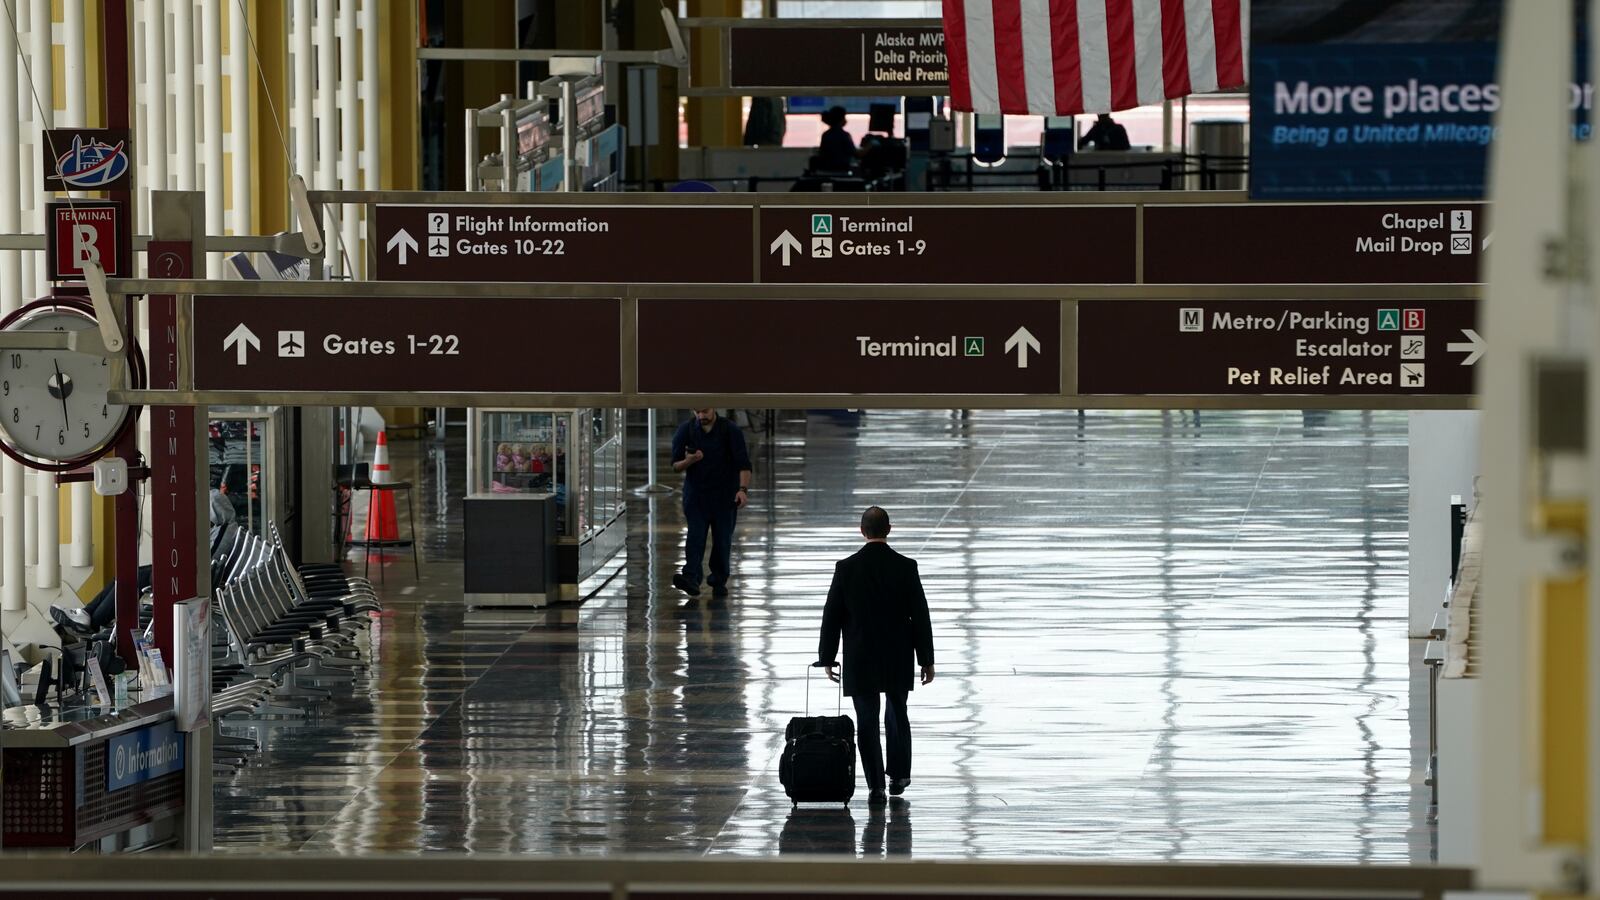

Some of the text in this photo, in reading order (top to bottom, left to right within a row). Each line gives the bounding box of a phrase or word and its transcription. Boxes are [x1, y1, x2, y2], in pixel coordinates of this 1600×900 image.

[875, 32, 945, 47] Alaska MVP
[874, 49, 905, 64] Delta
[874, 66, 950, 81] United Premi
[1274, 81, 1374, 114] More
[1384, 79, 1501, 119] places
[1271, 125, 1330, 147] Being
[1333, 127, 1349, 144] a
[1352, 123, 1421, 144] United
[60, 210, 112, 222] TERMINAL
[815, 215, 913, 233] A Terminal
[1381, 212, 1444, 233] Chapel
[455, 215, 609, 236] Flight Information
[72, 223, 100, 270] B
[456, 238, 565, 255] Gates 10-22
[839, 239, 927, 256] Gates 1-9
[1355, 235, 1444, 256] Mail Drop
[1211, 309, 1370, 335] Metro/Parking
[1380, 311, 1397, 329] A
[1408, 311, 1421, 329] B
[323, 333, 460, 355] Gates 1-22
[856, 335, 981, 357] Terminal A
[1296, 337, 1393, 357] Escalator
[11, 353, 22, 370] 10
[1227, 365, 1393, 386] Pet Relief Area
[3, 380, 10, 397] 9
[13, 407, 20, 424] 8
[101, 404, 108, 419] 4
[35, 425, 41, 441] 7
[58, 429, 65, 446] 6
[84, 422, 90, 439] 5
[127, 740, 179, 774] Information
